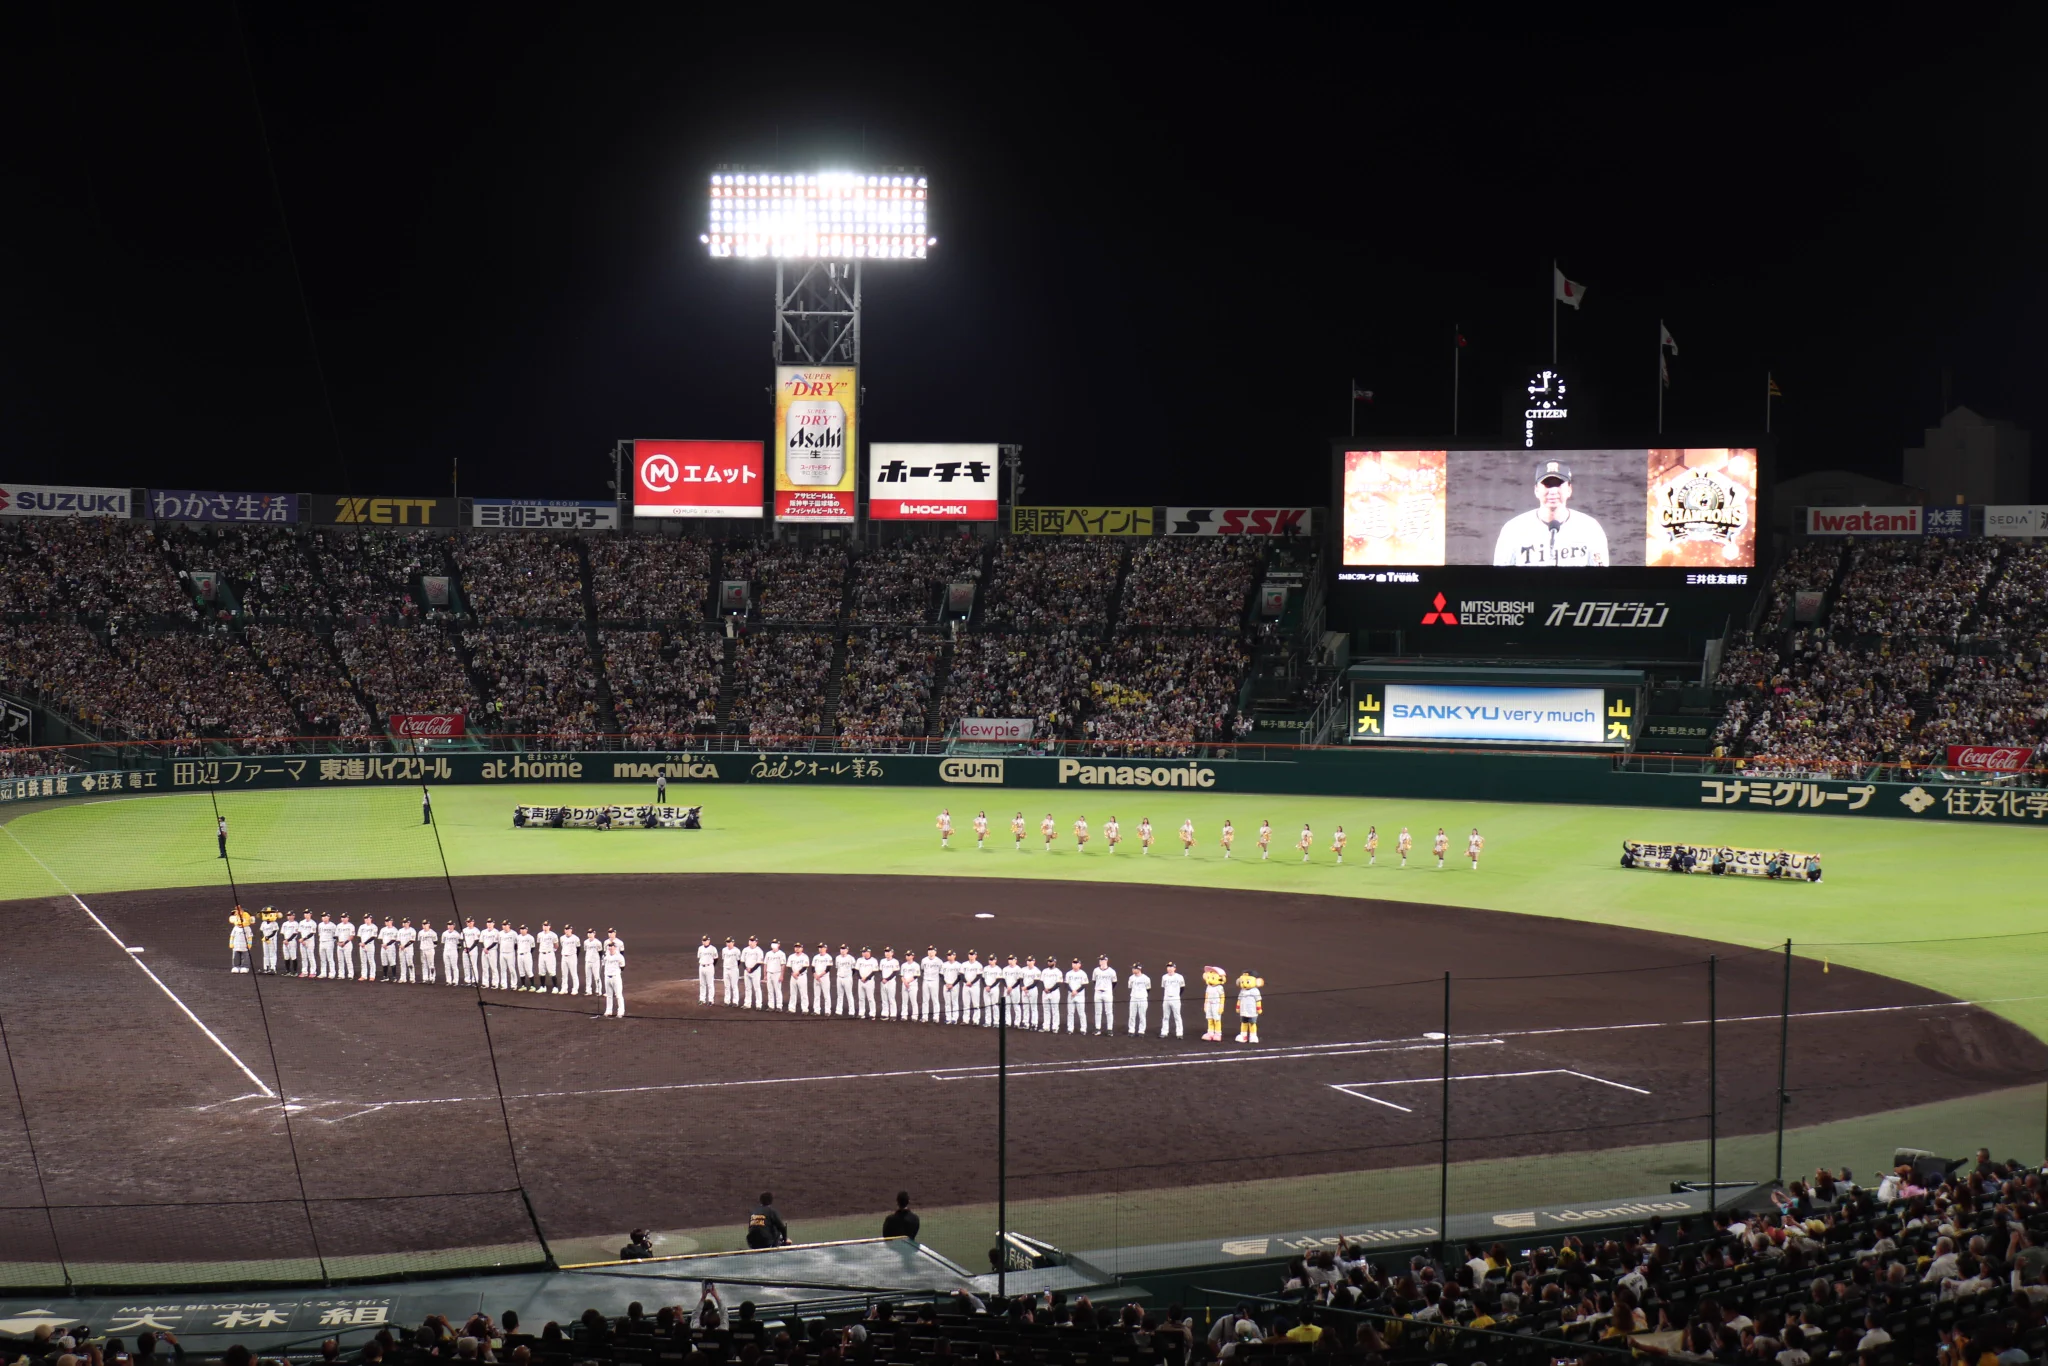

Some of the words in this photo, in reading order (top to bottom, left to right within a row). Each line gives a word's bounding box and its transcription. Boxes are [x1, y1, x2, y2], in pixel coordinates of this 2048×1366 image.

[1525, 409, 1568, 419] CITIZEN
[1526, 420, 1534, 429] B
[790, 426, 842, 448] Asahi
[1526, 429, 1534, 438] S
[810, 450, 822, 459] 生
[877, 460, 991, 483] ホーチキ
[16, 491, 125, 512] SUZUKI
[154, 491, 289, 522] わかさ生活
[334, 497, 437, 525] ZETT
[910, 505, 967, 515] HOCHIKI
[481, 506, 610, 527] 三和シャッター
[1014, 509, 1151, 534] 関西ペイント
[1217, 510, 1307, 534] SSK
[1659, 506, 1745, 525] CHAMPIONS
[1813, 510, 1917, 531] Iwatani
[1928, 509, 1962, 526] 水素
[1989, 515, 2028, 524] SEDIA
[1686, 574, 1748, 585] 三井住友銀行
[1460, 601, 1535, 613] MITSUBISHI
[1544, 602, 1670, 628] オーロラビジョン
[1460, 614, 1525, 626] ELECTRIC
[1358, 693, 1381, 734] 山九
[1392, 704, 1500, 721] SANKYU
[1502, 710, 1544, 725] very
[1547, 708, 1596, 723] much
[1607, 698, 1632, 740] 山九
[960, 720, 1020, 740] kewpie
[320, 756, 452, 780] 東進ハイスクール
[527, 753, 576, 762] 住まいさがし
[174, 760, 307, 786] 田辺ファーマ
[1058, 759, 1216, 788] Panasonic
[16, 777, 68, 799] 日鉄鋼板
[1701, 780, 1876, 810] コナミグループ
[1540, 1199, 1692, 1223] idemitsu
[1276, 1225, 1440, 1251] idemitsu
[118, 1305, 182, 1313] MAKE
[184, 1302, 271, 1312] BEYOND
[105, 1306, 390, 1332] 大林組
